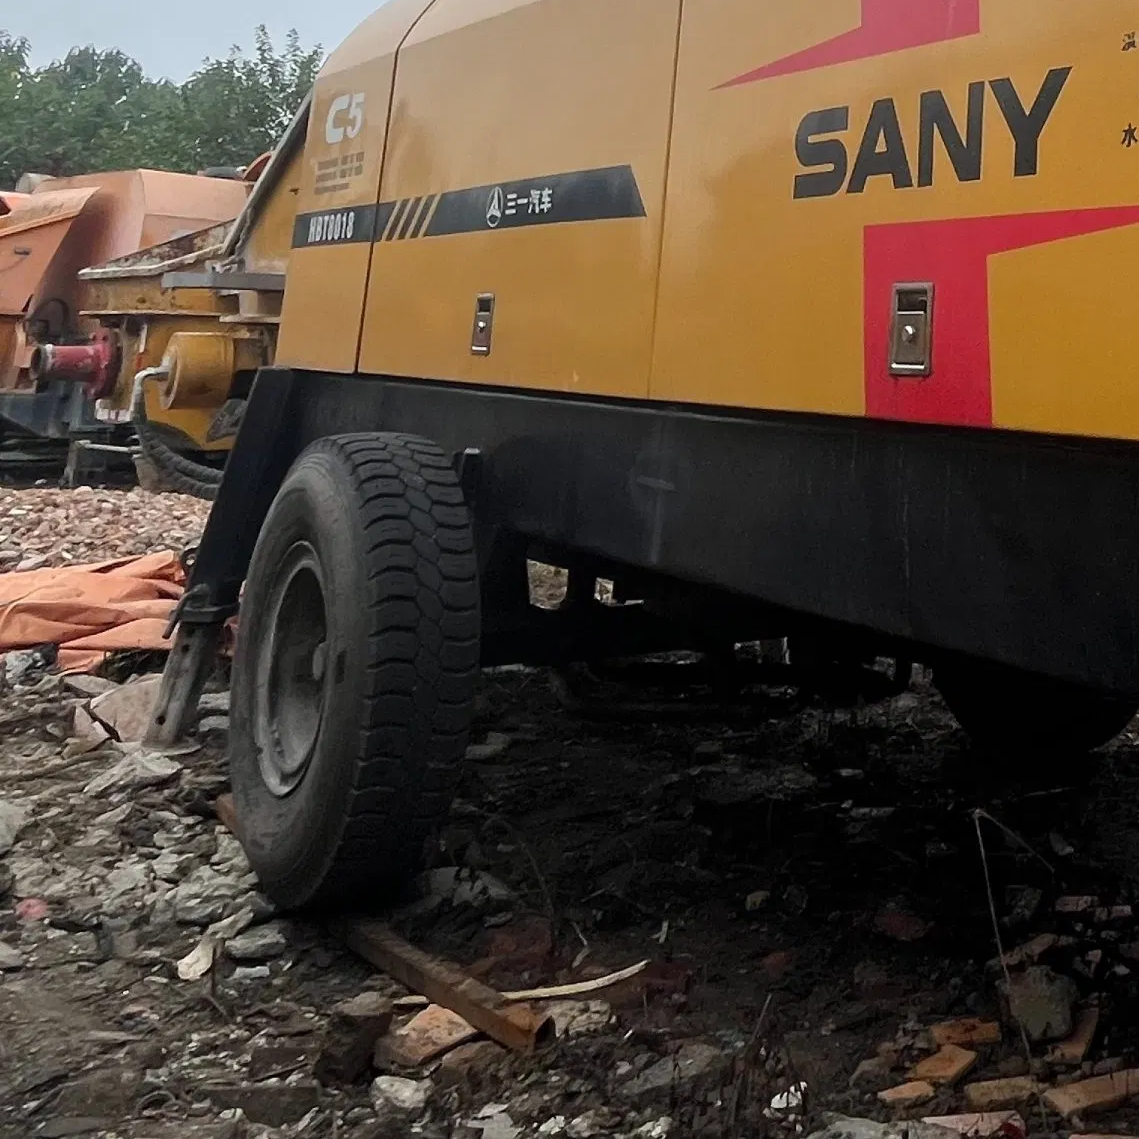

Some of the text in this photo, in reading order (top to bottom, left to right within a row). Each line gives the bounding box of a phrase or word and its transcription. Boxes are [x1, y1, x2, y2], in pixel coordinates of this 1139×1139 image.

[325, 92, 366, 144] C5
[793, 66, 1073, 199] SANY
[505, 187, 553, 215] 三一汽车
